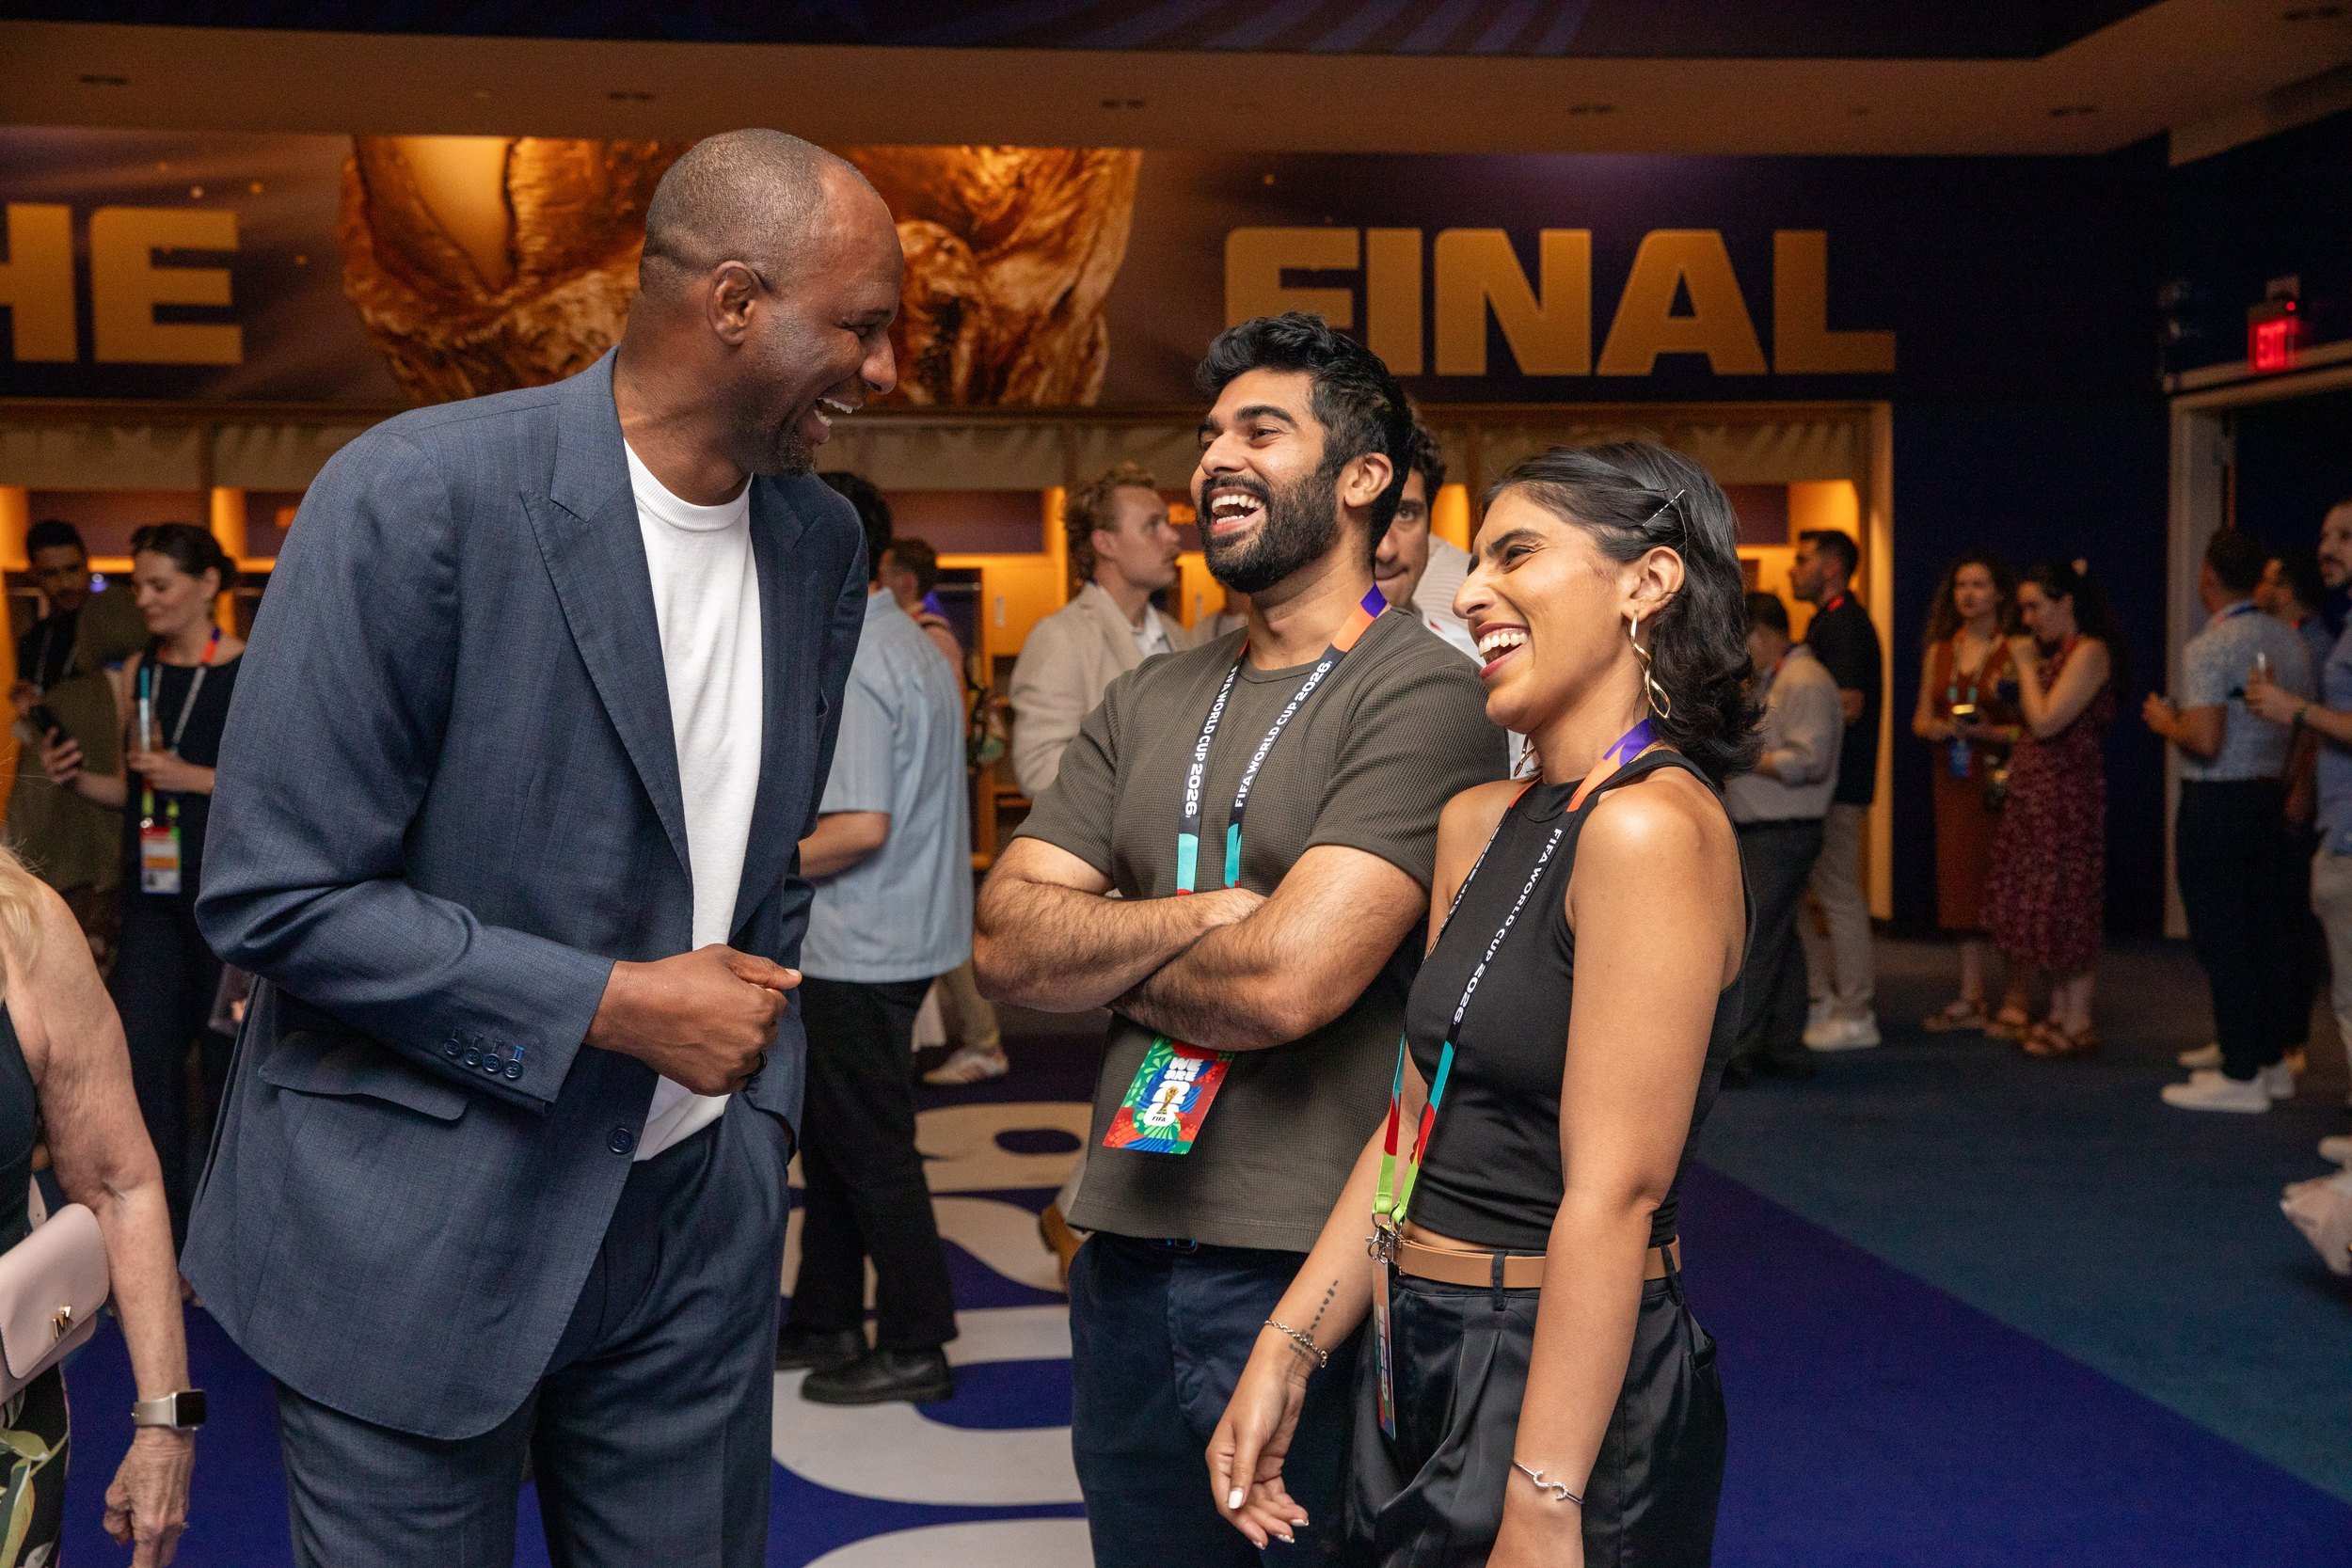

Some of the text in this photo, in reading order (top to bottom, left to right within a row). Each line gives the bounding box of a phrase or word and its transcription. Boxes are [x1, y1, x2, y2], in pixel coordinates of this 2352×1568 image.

[1225, 227, 1897, 377] FINAL
[1203, 690, 1229, 734] WORLD
[1234, 661, 1331, 808] FIFA WORLD CUP 2026
[1195, 735, 1211, 762] CUP
[1185, 763, 1203, 816] 2026
[1454, 828, 1563, 1023] FIFA WORLD CUP 2026
[1164, 1069, 1198, 1081] ARE
[1169, 1057, 1204, 1071] WE
